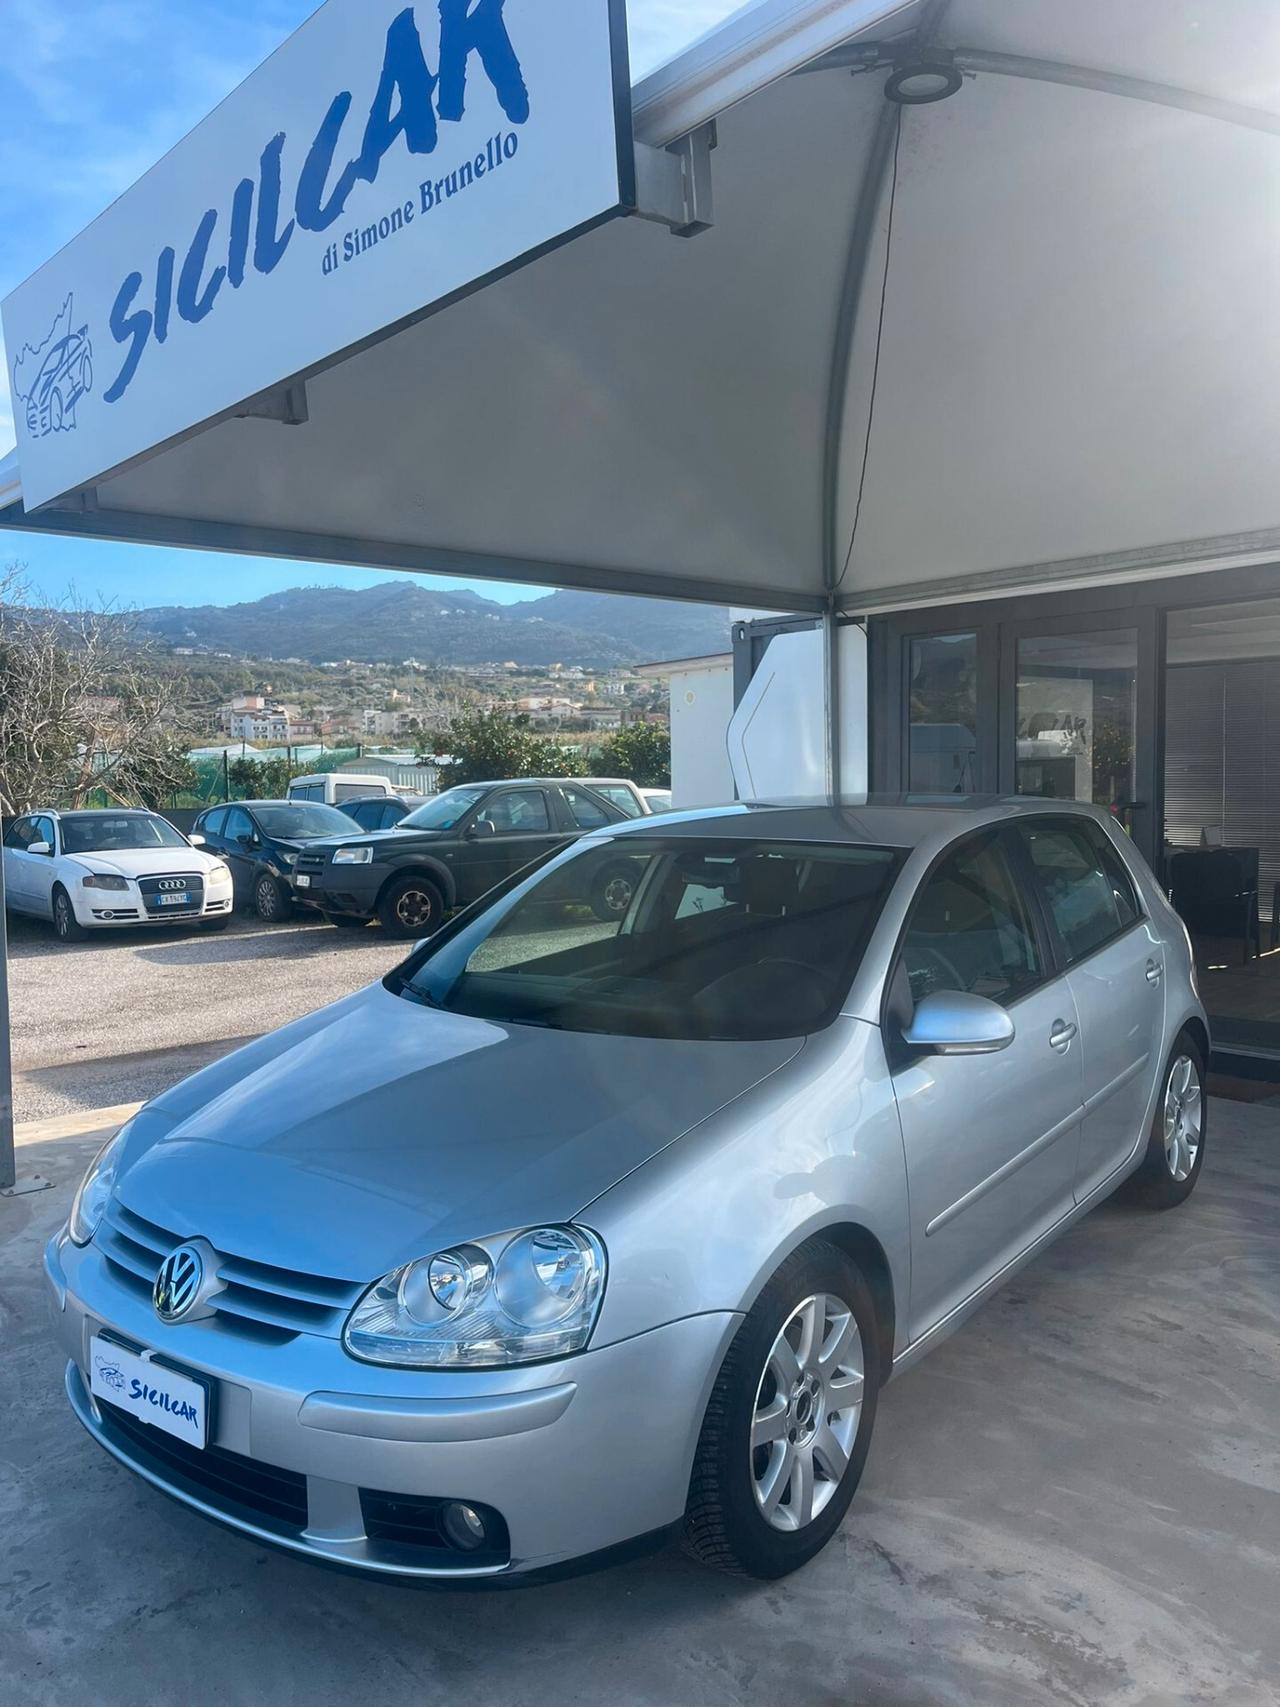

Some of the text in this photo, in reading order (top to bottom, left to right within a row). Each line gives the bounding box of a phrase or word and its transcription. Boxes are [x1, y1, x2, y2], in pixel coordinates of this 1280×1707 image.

[322, 131, 518, 275] di Simone Brunello
[129, 1378, 198, 1429] SICILCAR
